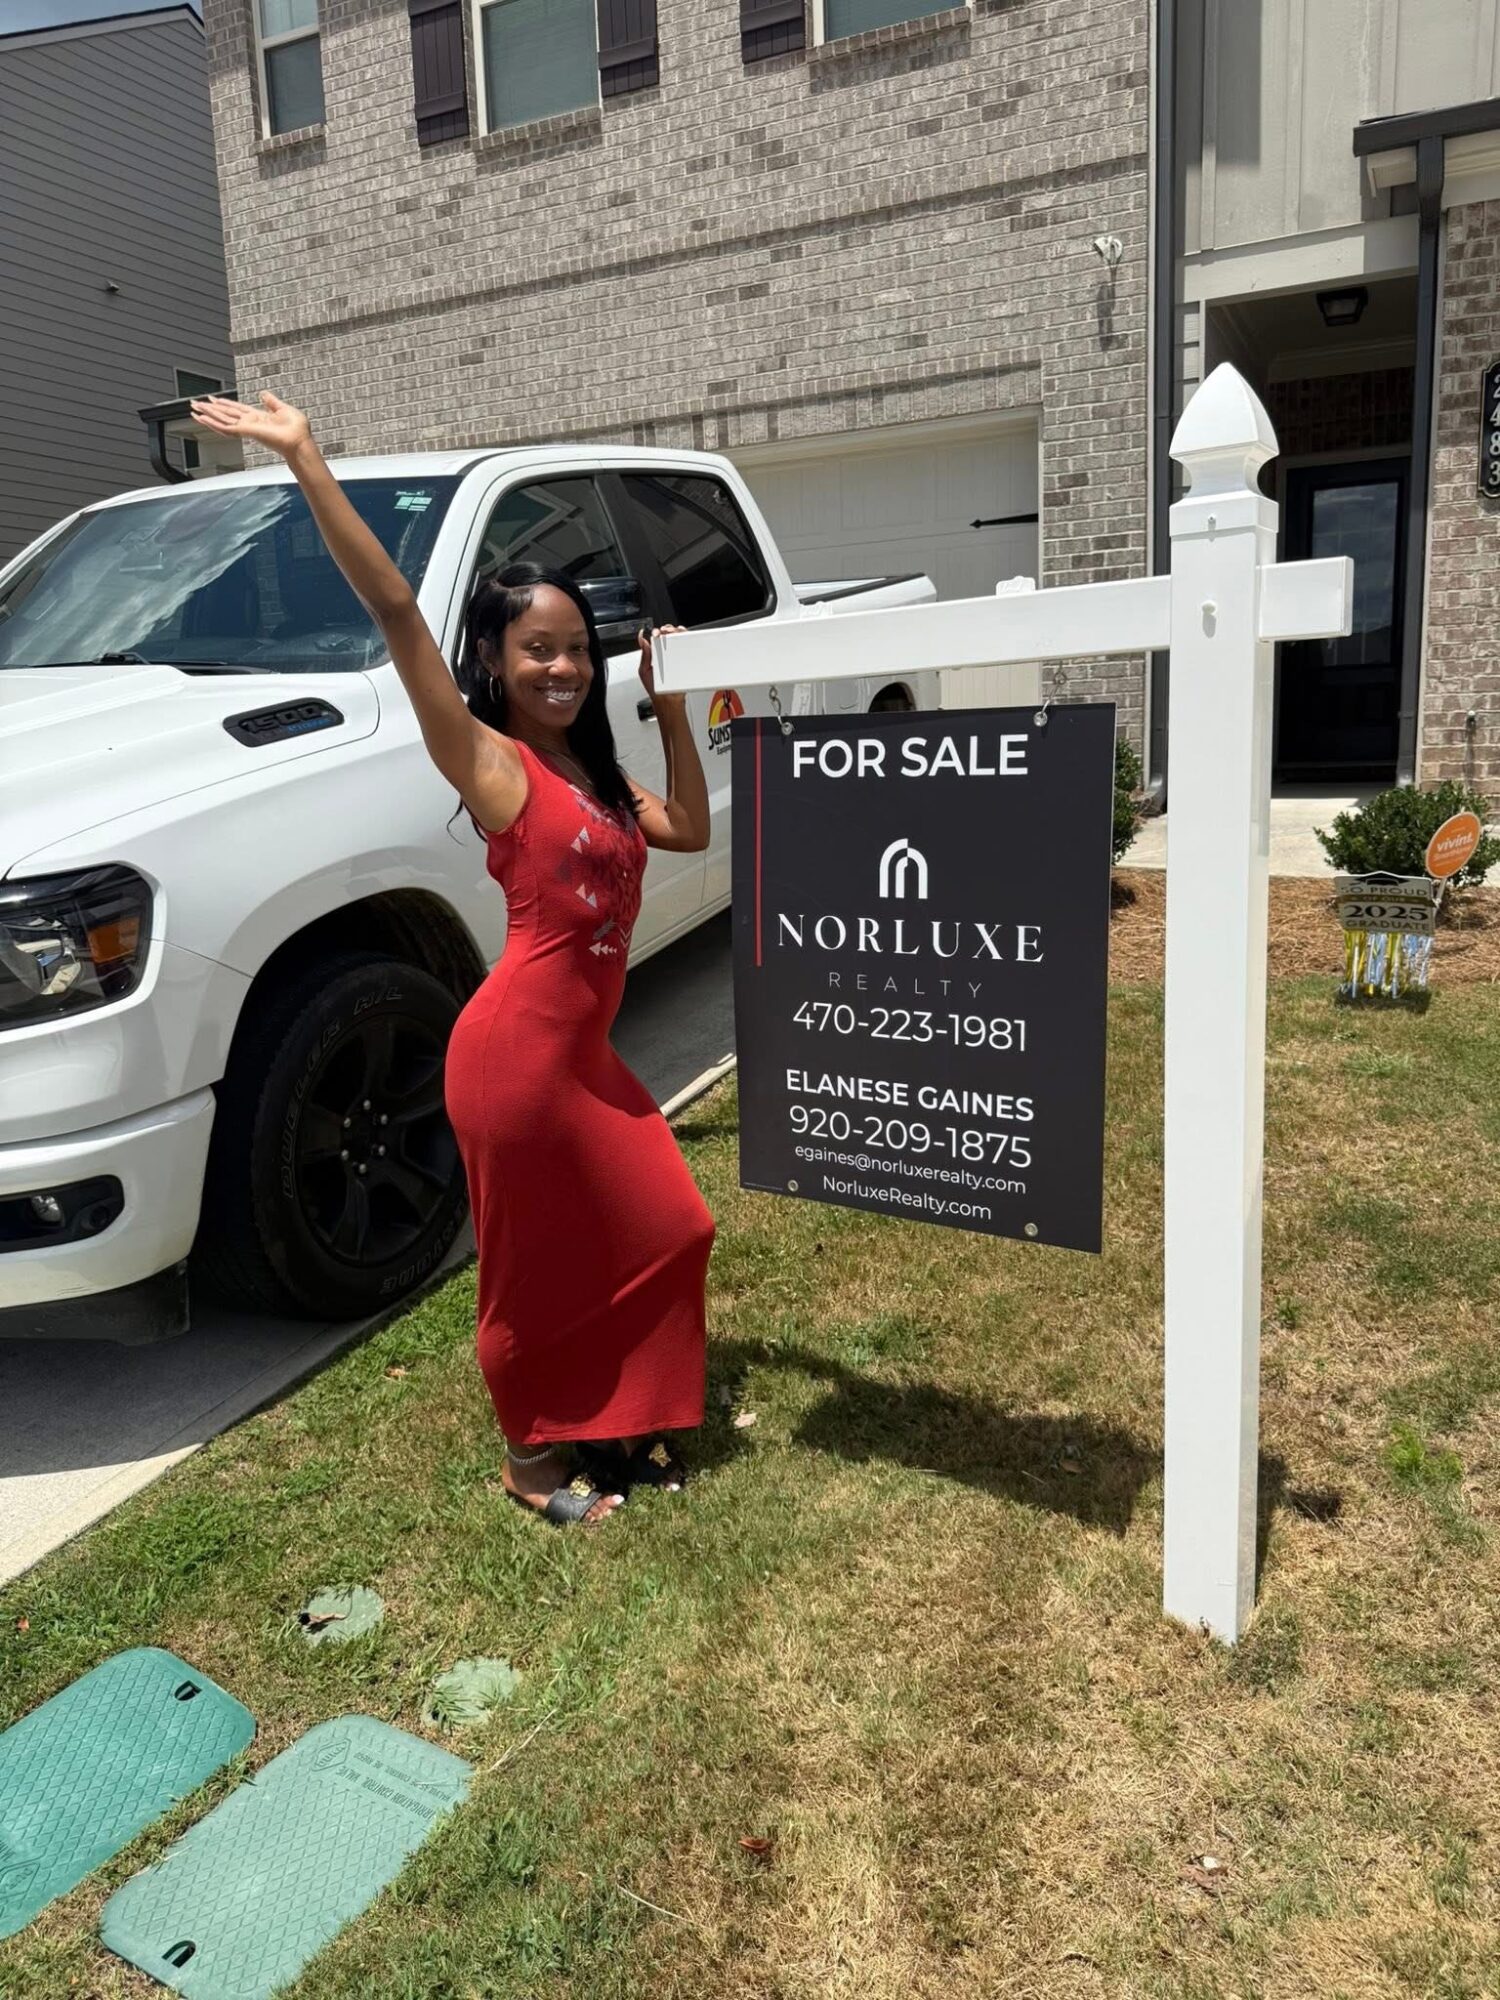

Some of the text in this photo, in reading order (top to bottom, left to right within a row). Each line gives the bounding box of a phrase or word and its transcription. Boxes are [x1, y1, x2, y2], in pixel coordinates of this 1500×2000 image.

[239, 703, 323, 734] 1500
[793, 733, 1029, 778] FOR SALE
[1343, 904, 1429, 921] 2025
[1370, 887, 1428, 896] PROUD
[778, 913, 1045, 963] NORLUXE
[1345, 919, 1430, 932] GRADUATE
[828, 971, 983, 999] REALTY
[793, 1001, 1027, 1052] 470-223-1981
[786, 1068, 1035, 1123] ELANESE GAINES
[789, 1104, 1032, 1169] 920-209-1875
[795, 1145, 1027, 1195] egaines@norluxerealty.com
[822, 1174, 992, 1220] NorluxeRealty.com
